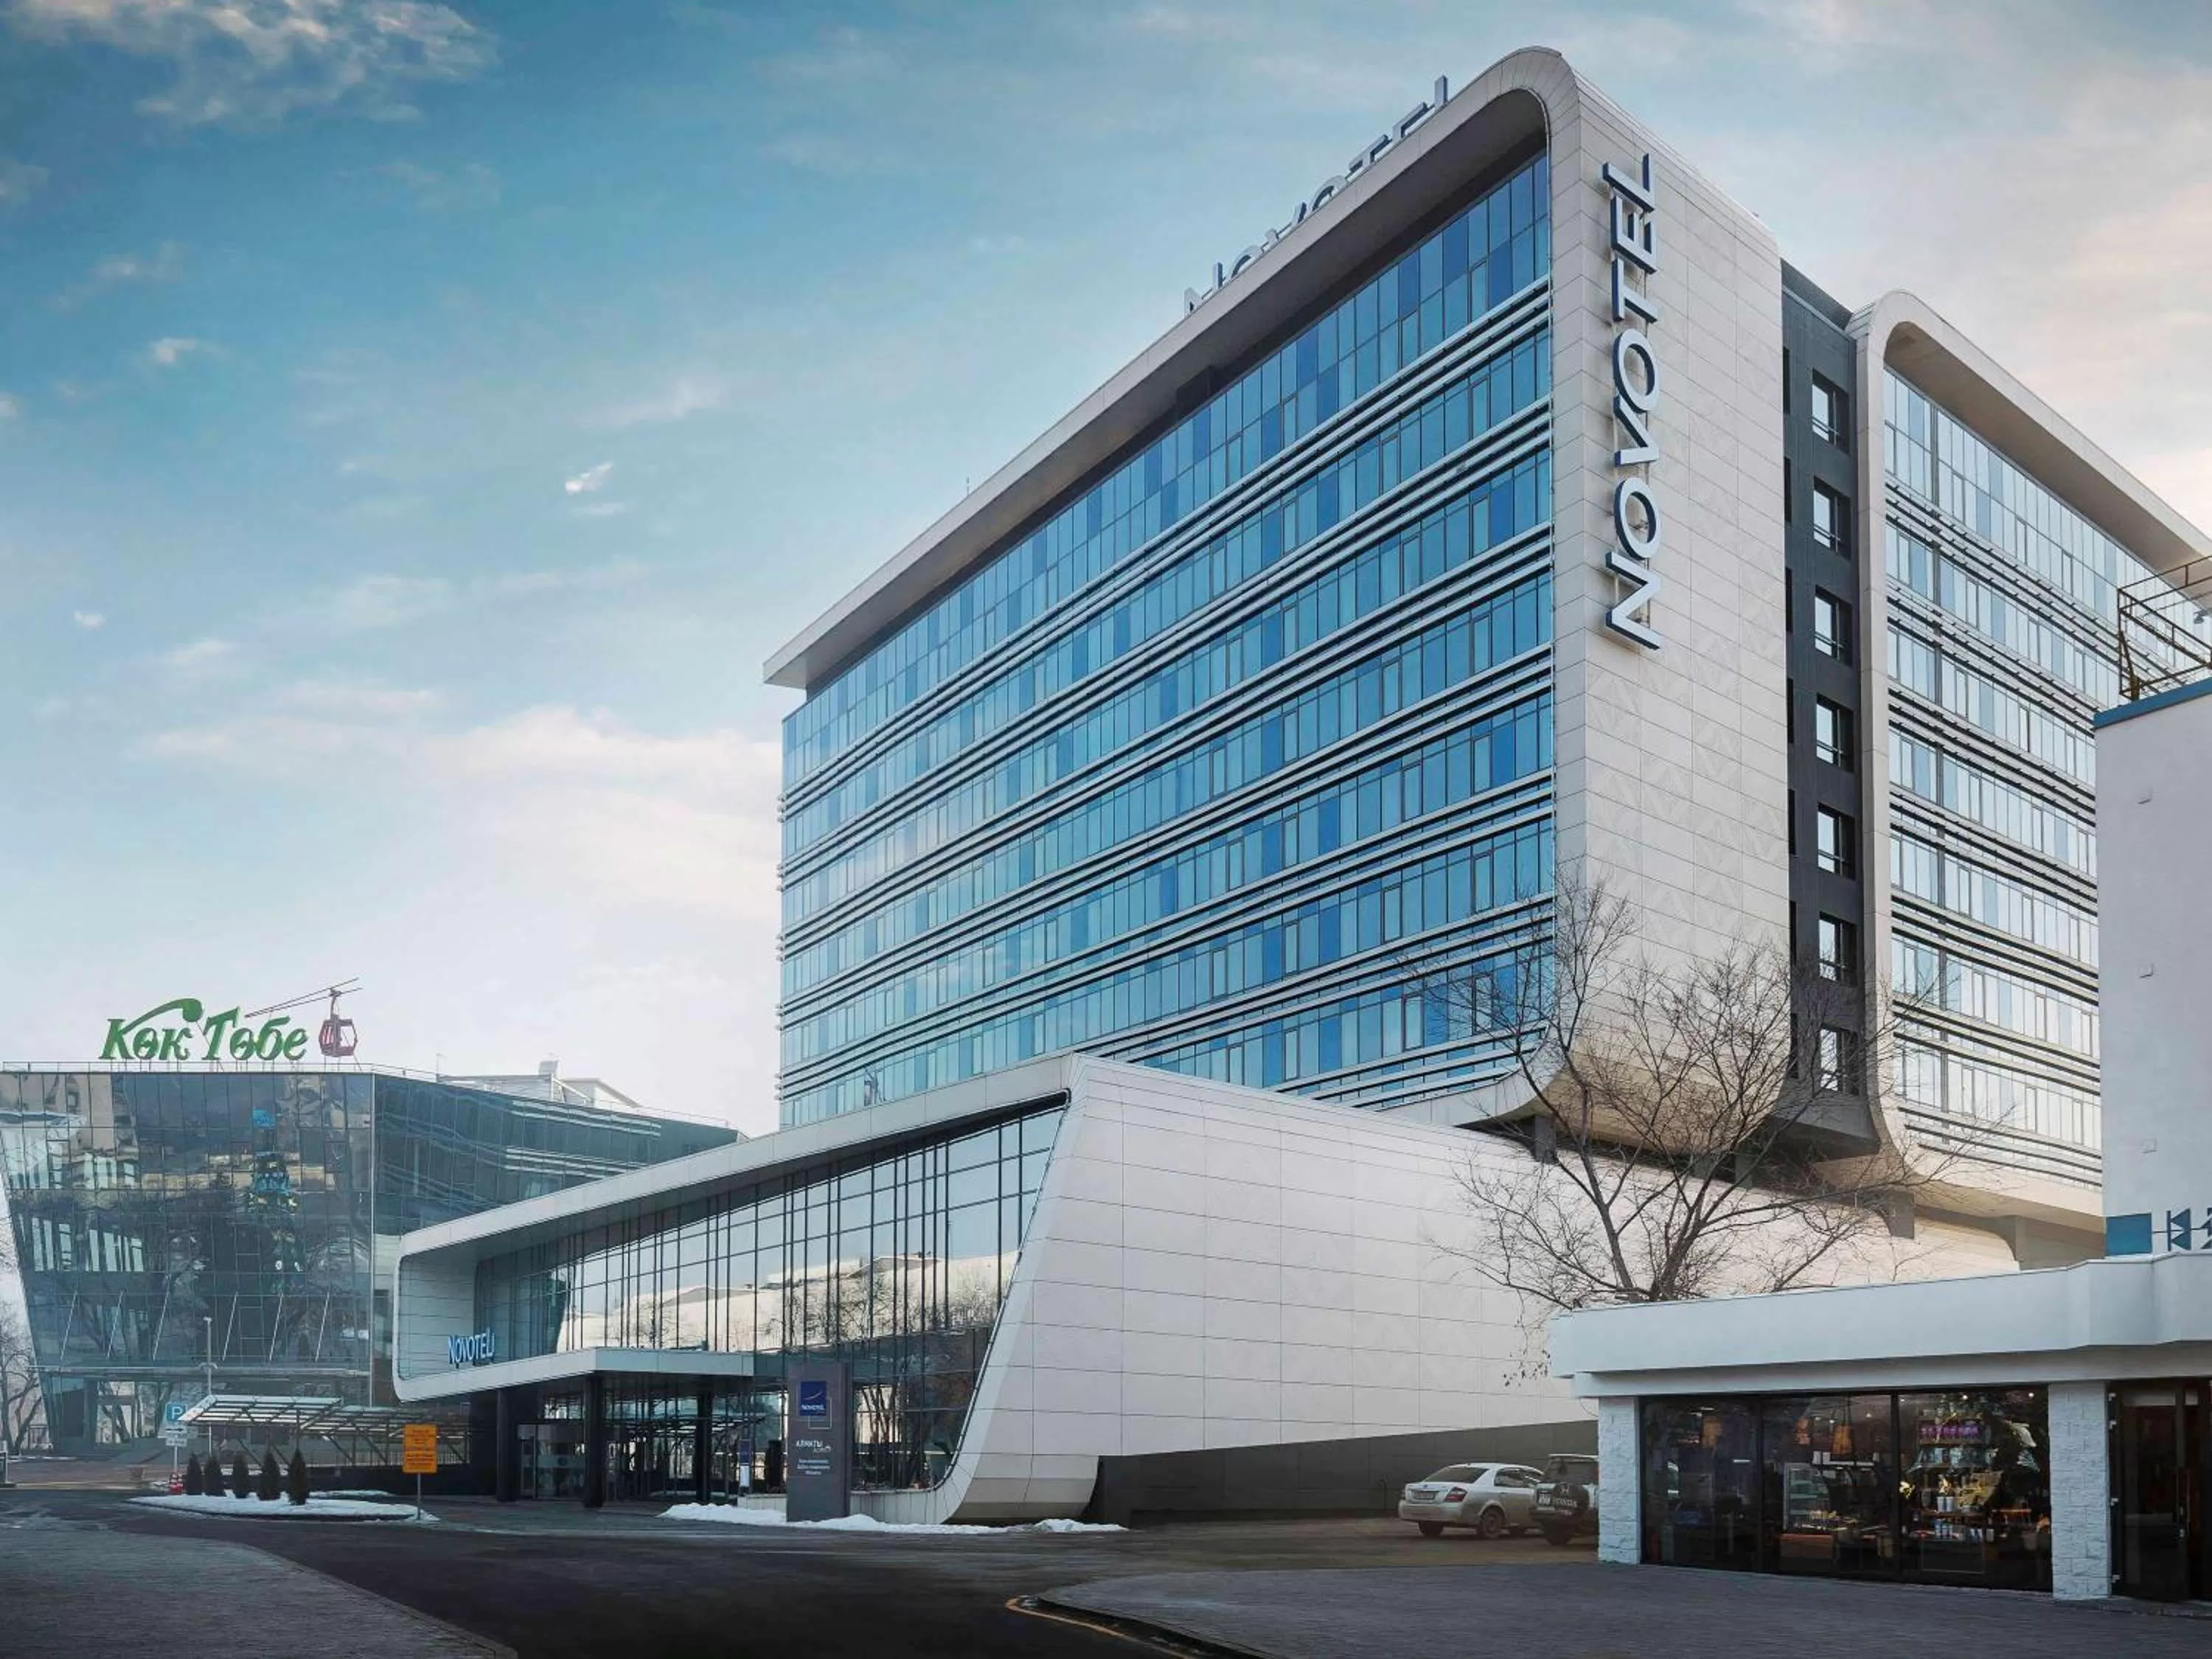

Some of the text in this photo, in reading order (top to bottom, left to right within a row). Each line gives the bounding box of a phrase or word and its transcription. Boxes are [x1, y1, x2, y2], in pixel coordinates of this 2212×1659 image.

[1602, 153, 1661, 650] NOVOTEL
[98, 998, 309, 1060] Көк Төбе
[448, 1326, 495, 1364] NOVOTEL
[171, 1406, 184, 1420] P
